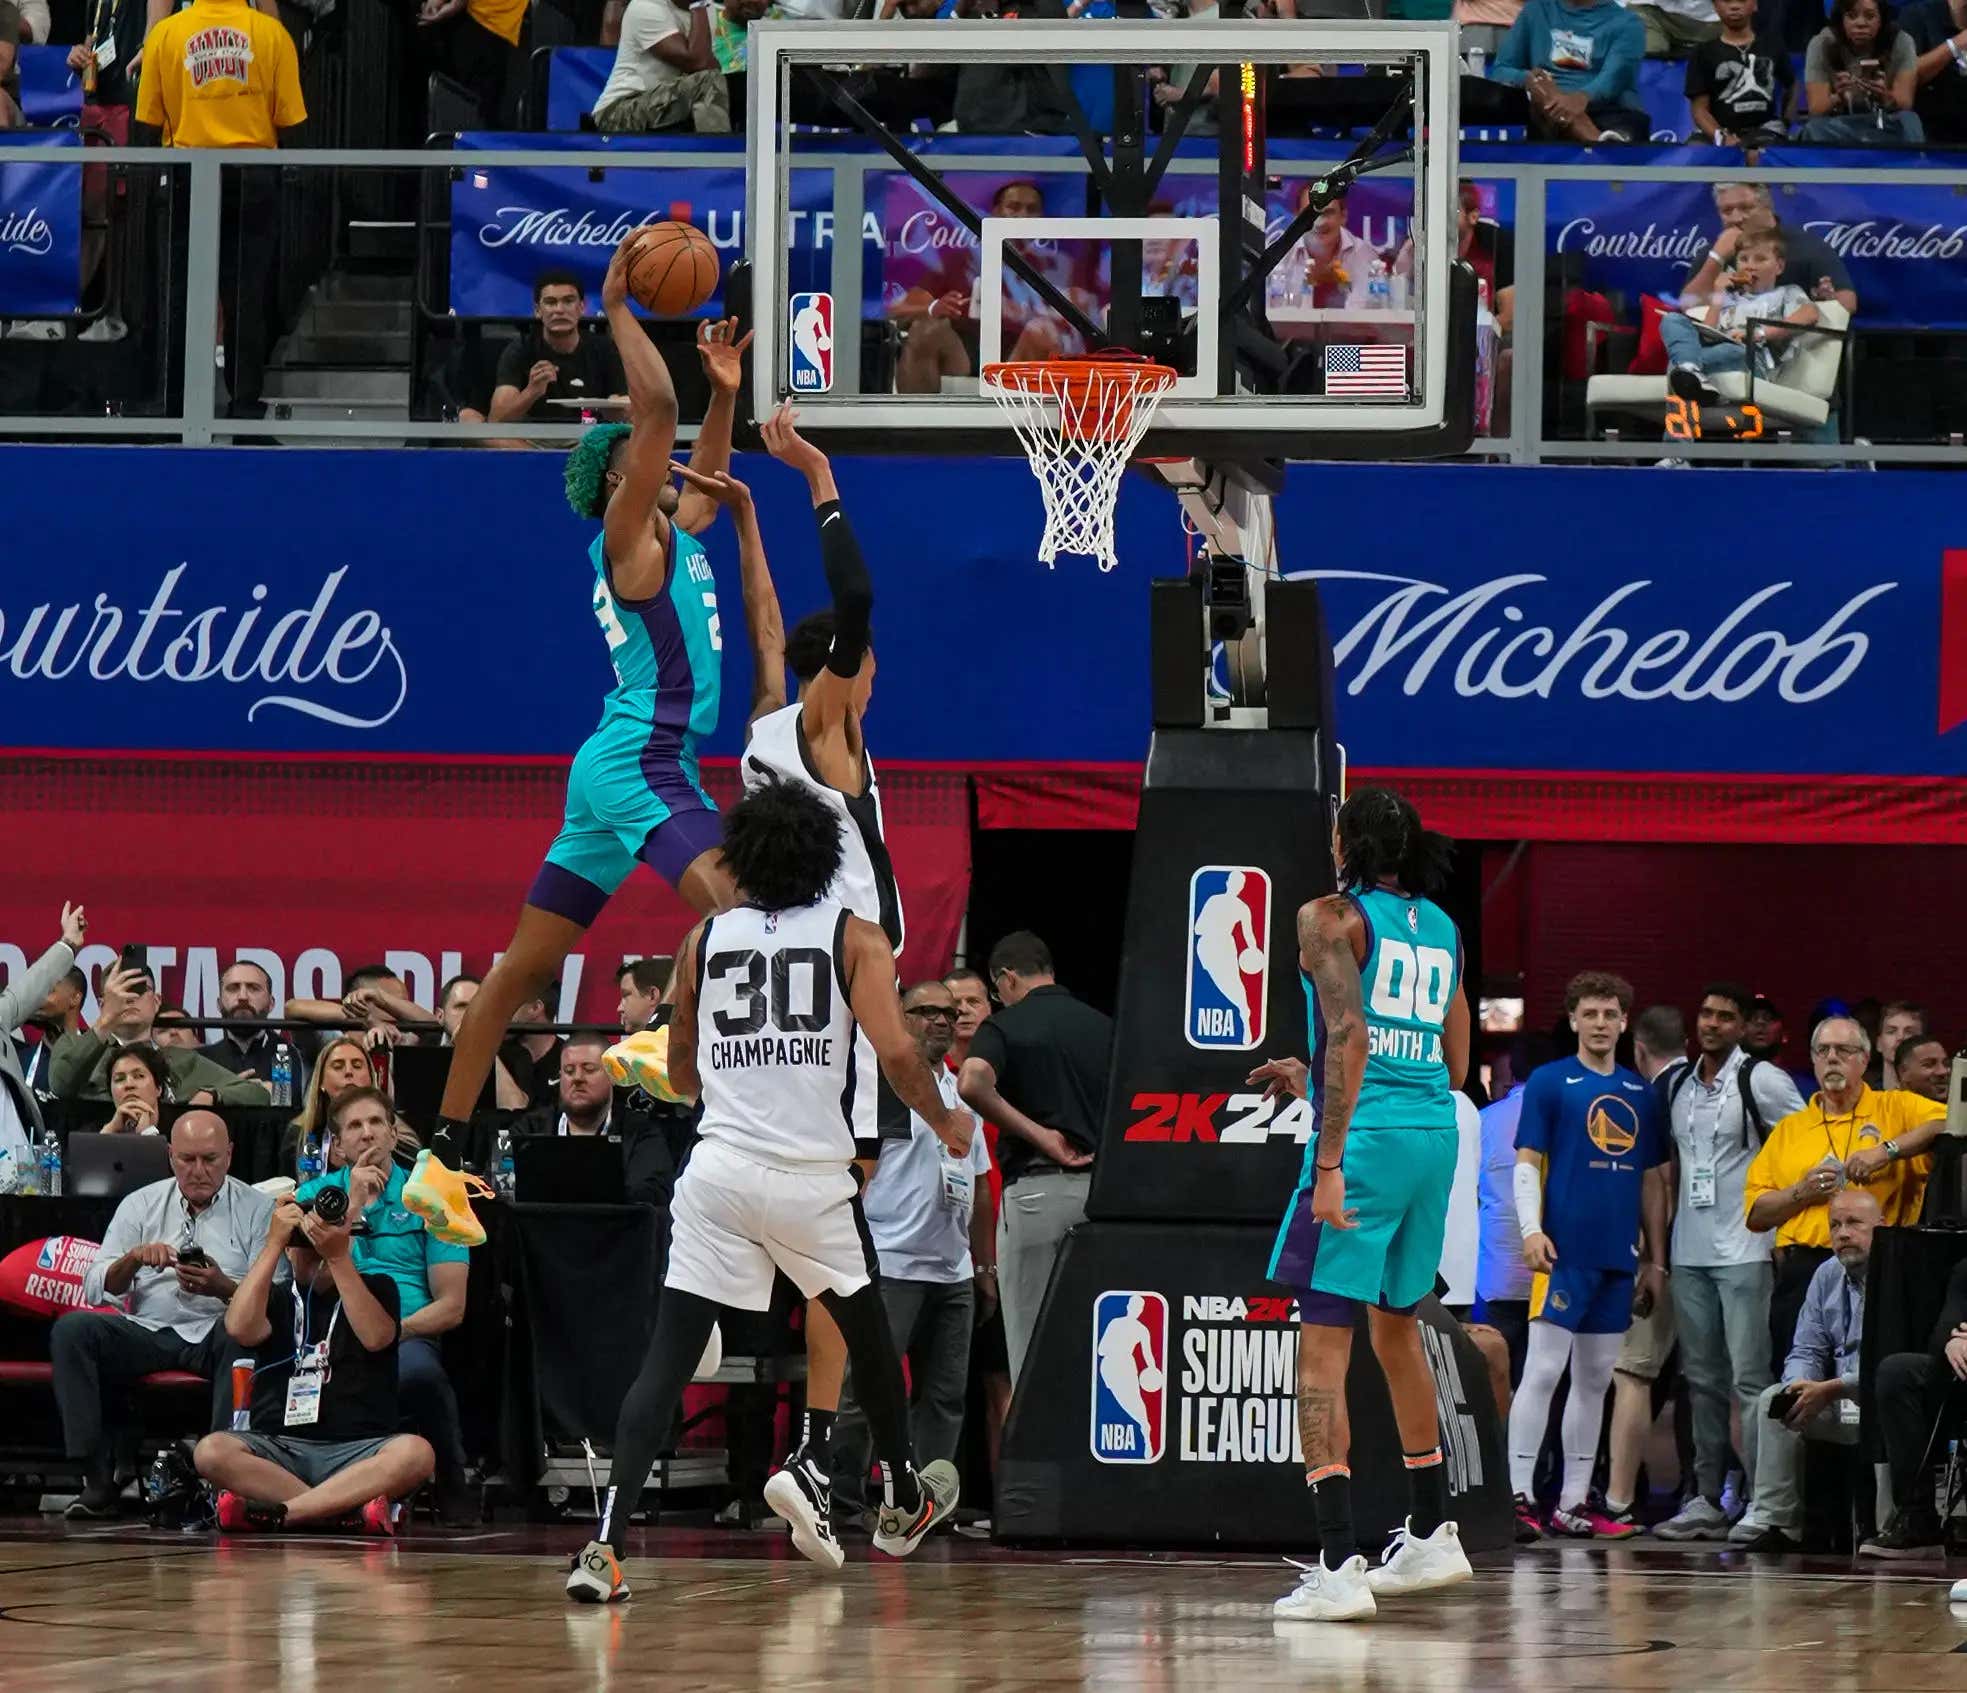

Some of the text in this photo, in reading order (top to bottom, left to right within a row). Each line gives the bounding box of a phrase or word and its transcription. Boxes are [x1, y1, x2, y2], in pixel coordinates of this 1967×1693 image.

[0, 206, 53, 255] ide
[708, 210, 886, 249] UTRA
[796, 369, 817, 386] NBA
[0, 561, 407, 729] urtside
[1281, 569, 1900, 704] Michelob
[707, 947, 832, 1038] 30
[1371, 937, 1453, 1026] 00
[1197, 1007, 1235, 1037] NBA
[711, 1037, 833, 1070] CHAMPAGNIE
[1368, 1024, 1424, 1063] SMITH
[1124, 1093, 1315, 1144] 2K24
[60, 1257, 88, 1276] LEAG
[66, 1242, 98, 1263] SUMM
[25, 1273, 94, 1310] RESERV
[1182, 1328, 1300, 1395] SUMM
[1101, 1423, 1136, 1451] NBA
